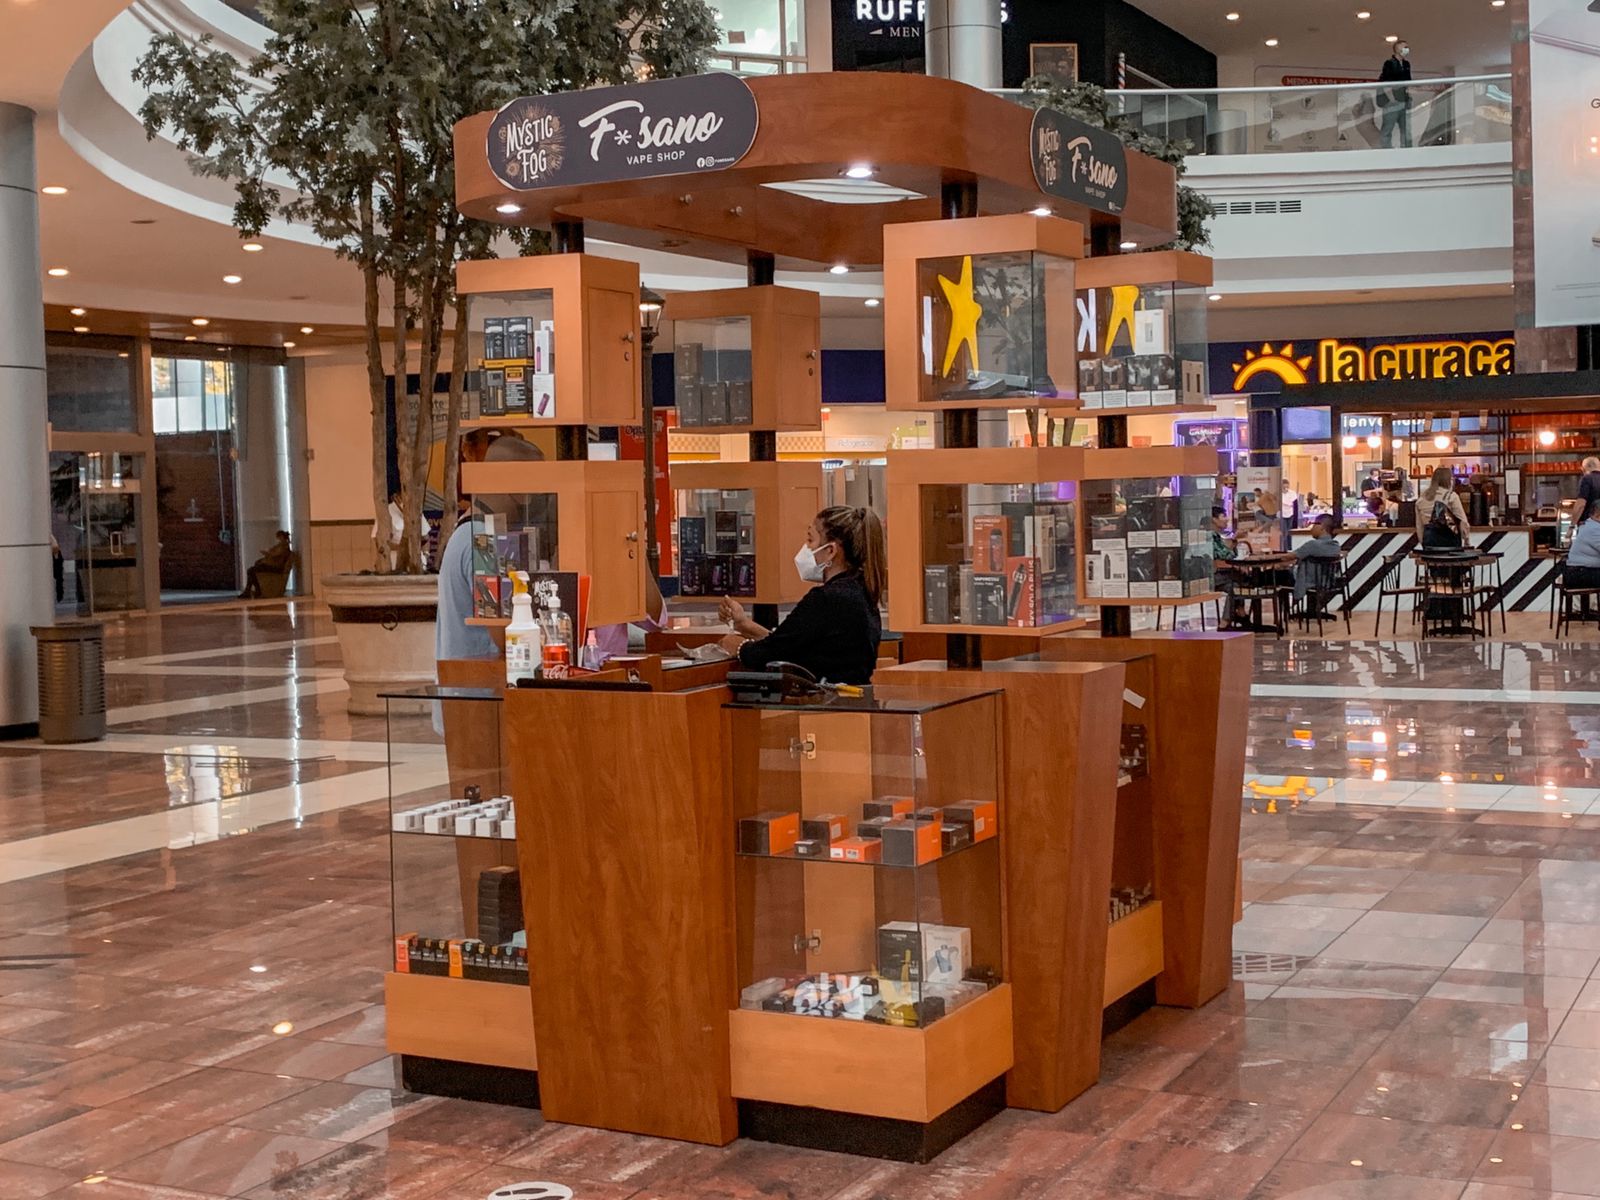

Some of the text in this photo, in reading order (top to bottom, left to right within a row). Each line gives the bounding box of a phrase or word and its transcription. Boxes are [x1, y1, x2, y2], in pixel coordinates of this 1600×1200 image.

[856, 0, 1009, 22] RUFFS
[890, 27, 921, 38] MEN
[506, 114, 555, 157] MYSTIC
[517, 149, 548, 183] FOG
[626, 150, 686, 166] VAPE SHOP
[1320, 338, 1516, 384] la curaca
